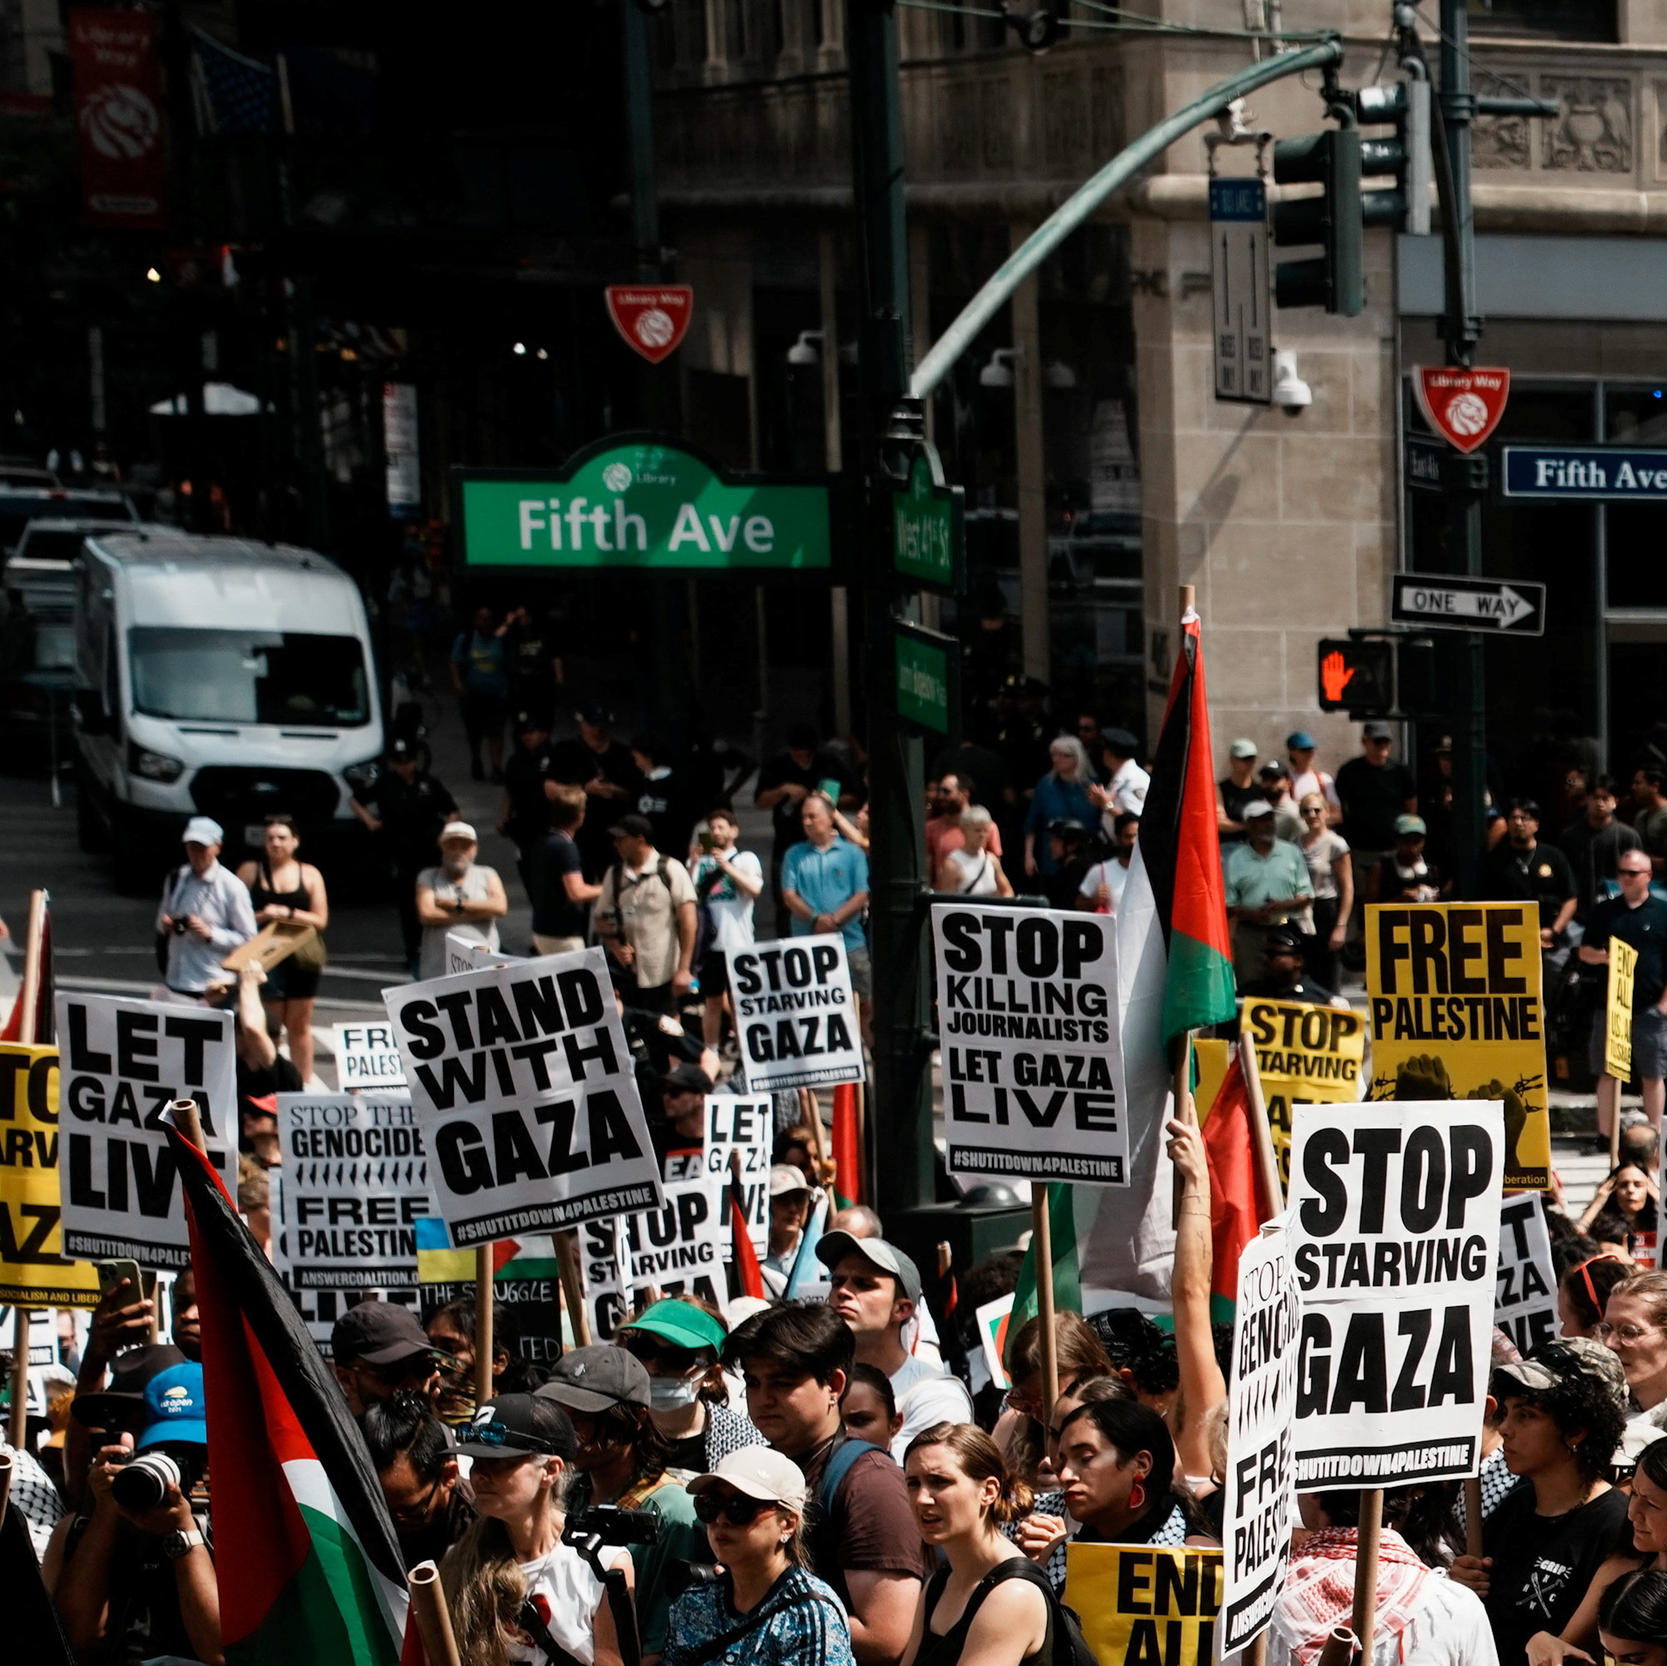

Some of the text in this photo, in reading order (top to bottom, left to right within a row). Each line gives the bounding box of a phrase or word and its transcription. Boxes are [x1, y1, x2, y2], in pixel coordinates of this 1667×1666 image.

[1429, 375, 1502, 391] Library Way
[1535, 457, 1607, 488] Fifth
[518, 500, 776, 553] Fifth Ave
[1414, 592, 1521, 618] ONE WAY
[734, 945, 840, 995] STOP
[944, 912, 1104, 980] STOP
[1379, 908, 1527, 995] FREE
[400, 967, 605, 1060] STAND
[741, 986, 846, 1018] STARVING
[946, 975, 1109, 1018] KILLING
[1373, 995, 1541, 1042] PALESTINE
[66, 1003, 223, 1088] LET
[747, 1014, 854, 1064] GAZA
[947, 1014, 1110, 1044] JOURNALISTS
[1250, 1004, 1358, 1052] STOP
[414, 1026, 620, 1112] WITH
[949, 1047, 1113, 1092] LET GAZA
[290, 1104, 359, 1127] STOP
[952, 1089, 1119, 1133] LIVE
[434, 1089, 644, 1197] GAZA
[953, 1149, 1119, 1179] #SHUTITDOWN4PALESTINE
[1300, 1123, 1494, 1238] STOP
[456, 1187, 653, 1242] #SHUTITDOWN4PALESTINE
[1296, 1234, 1487, 1291] STARVING
[422, 1281, 457, 1303] THE
[1294, 1304, 1475, 1419] GAZA
[1539, 1558, 1567, 1575] GRIP
